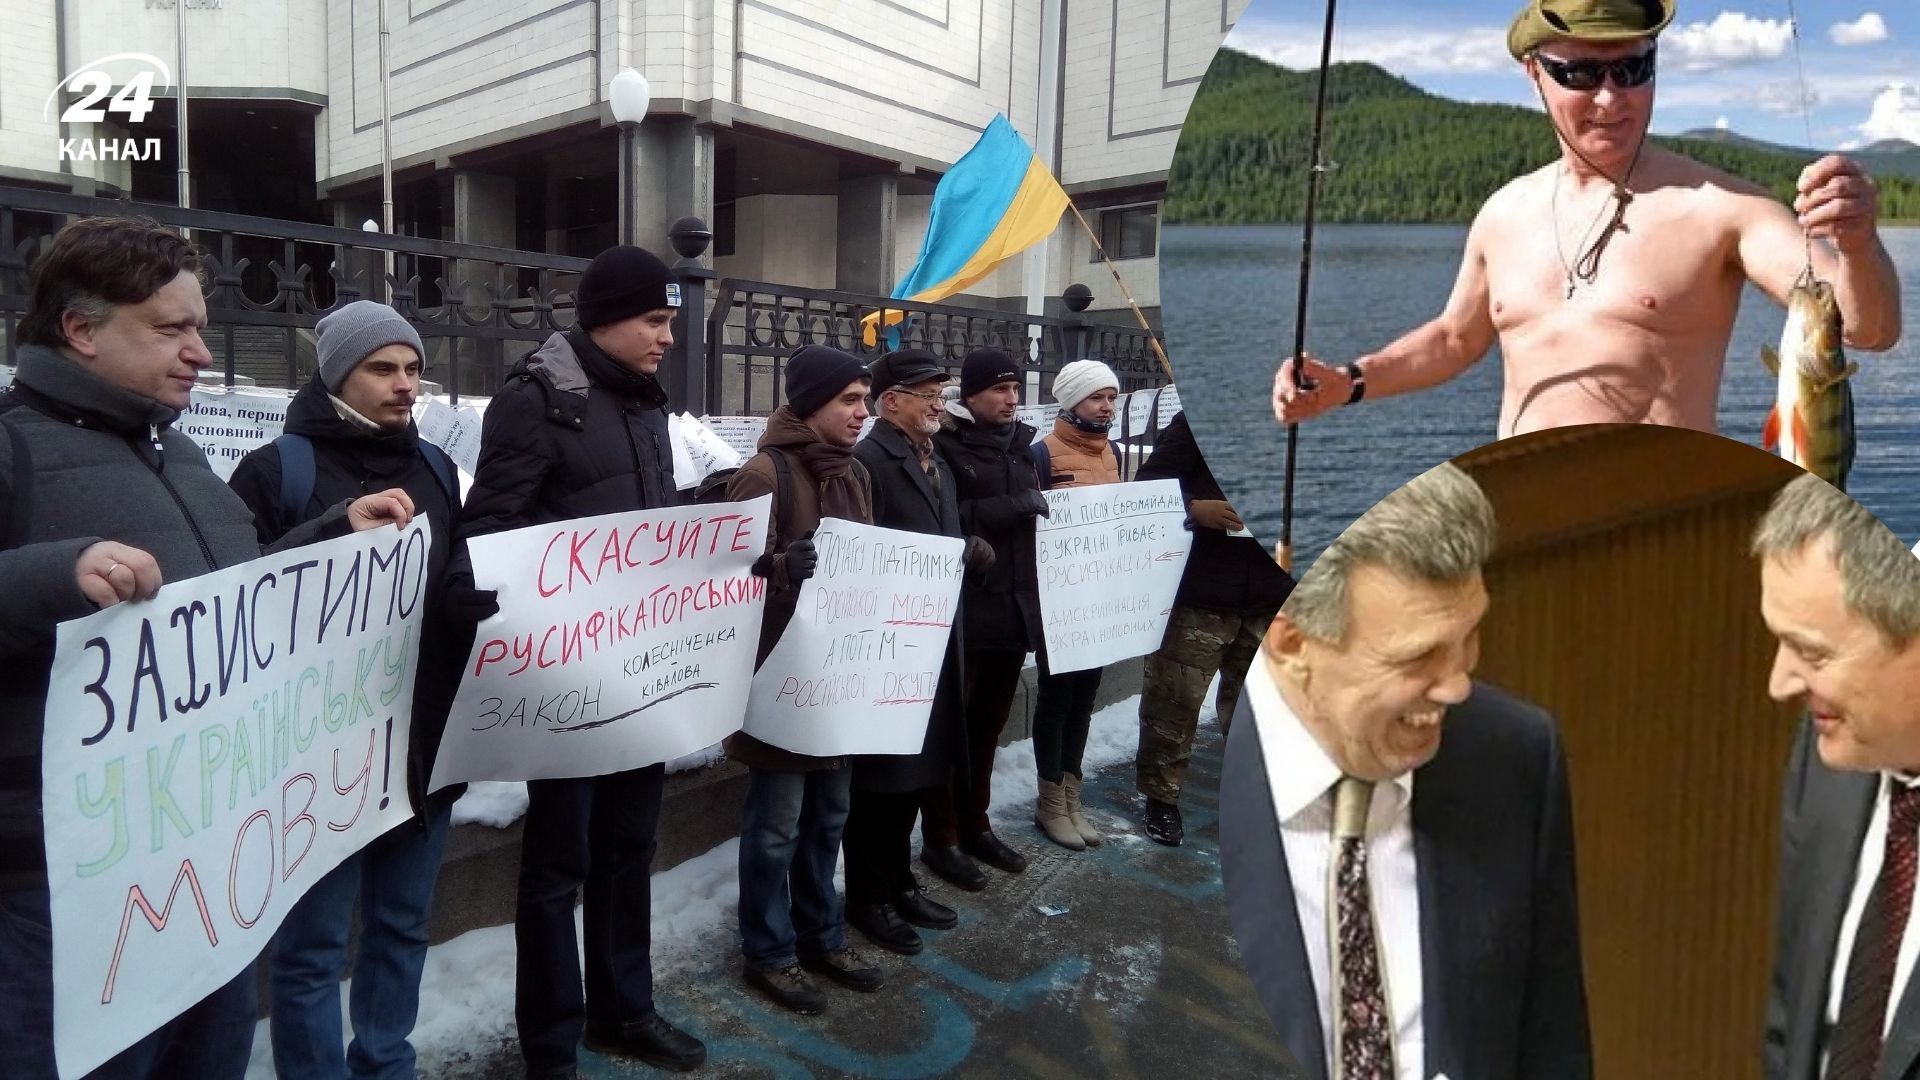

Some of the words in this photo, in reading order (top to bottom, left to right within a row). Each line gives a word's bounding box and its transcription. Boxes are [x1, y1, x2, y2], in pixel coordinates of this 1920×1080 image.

[185, 403, 231, 419] Мова,
[237, 408, 287, 422] перши
[188, 425, 264, 439] основний
[202, 443, 216, 456] іб
[221, 448, 253, 461] про
[1042, 491, 1070, 504] ТИРИ
[1080, 502, 1108, 523] ПІСЛЯ
[538, 514, 754, 598] СКАСУЙТЕ
[813, 532, 865, 578] ПОЧАТКУ
[872, 543, 962, 580] ПІДТРИМКА
[1039, 541, 1049, 563] В
[1046, 549, 1152, 591] РУСИФІКАЦІЯ
[891, 592, 949, 624] МОВИ
[81, 527, 426, 747] ЗАХИСТИМО
[622, 626, 736, 680] КОЛЕСНІЧЕНКА
[839, 629, 896, 664] ПОТІМ
[641, 663, 701, 699] КІВАЛОВА
[471, 679, 603, 732] ЗАКОН
[75, 624, 412, 878] УКРАЇНСЬКУ
[101, 716, 394, 1005] МОВУ!
